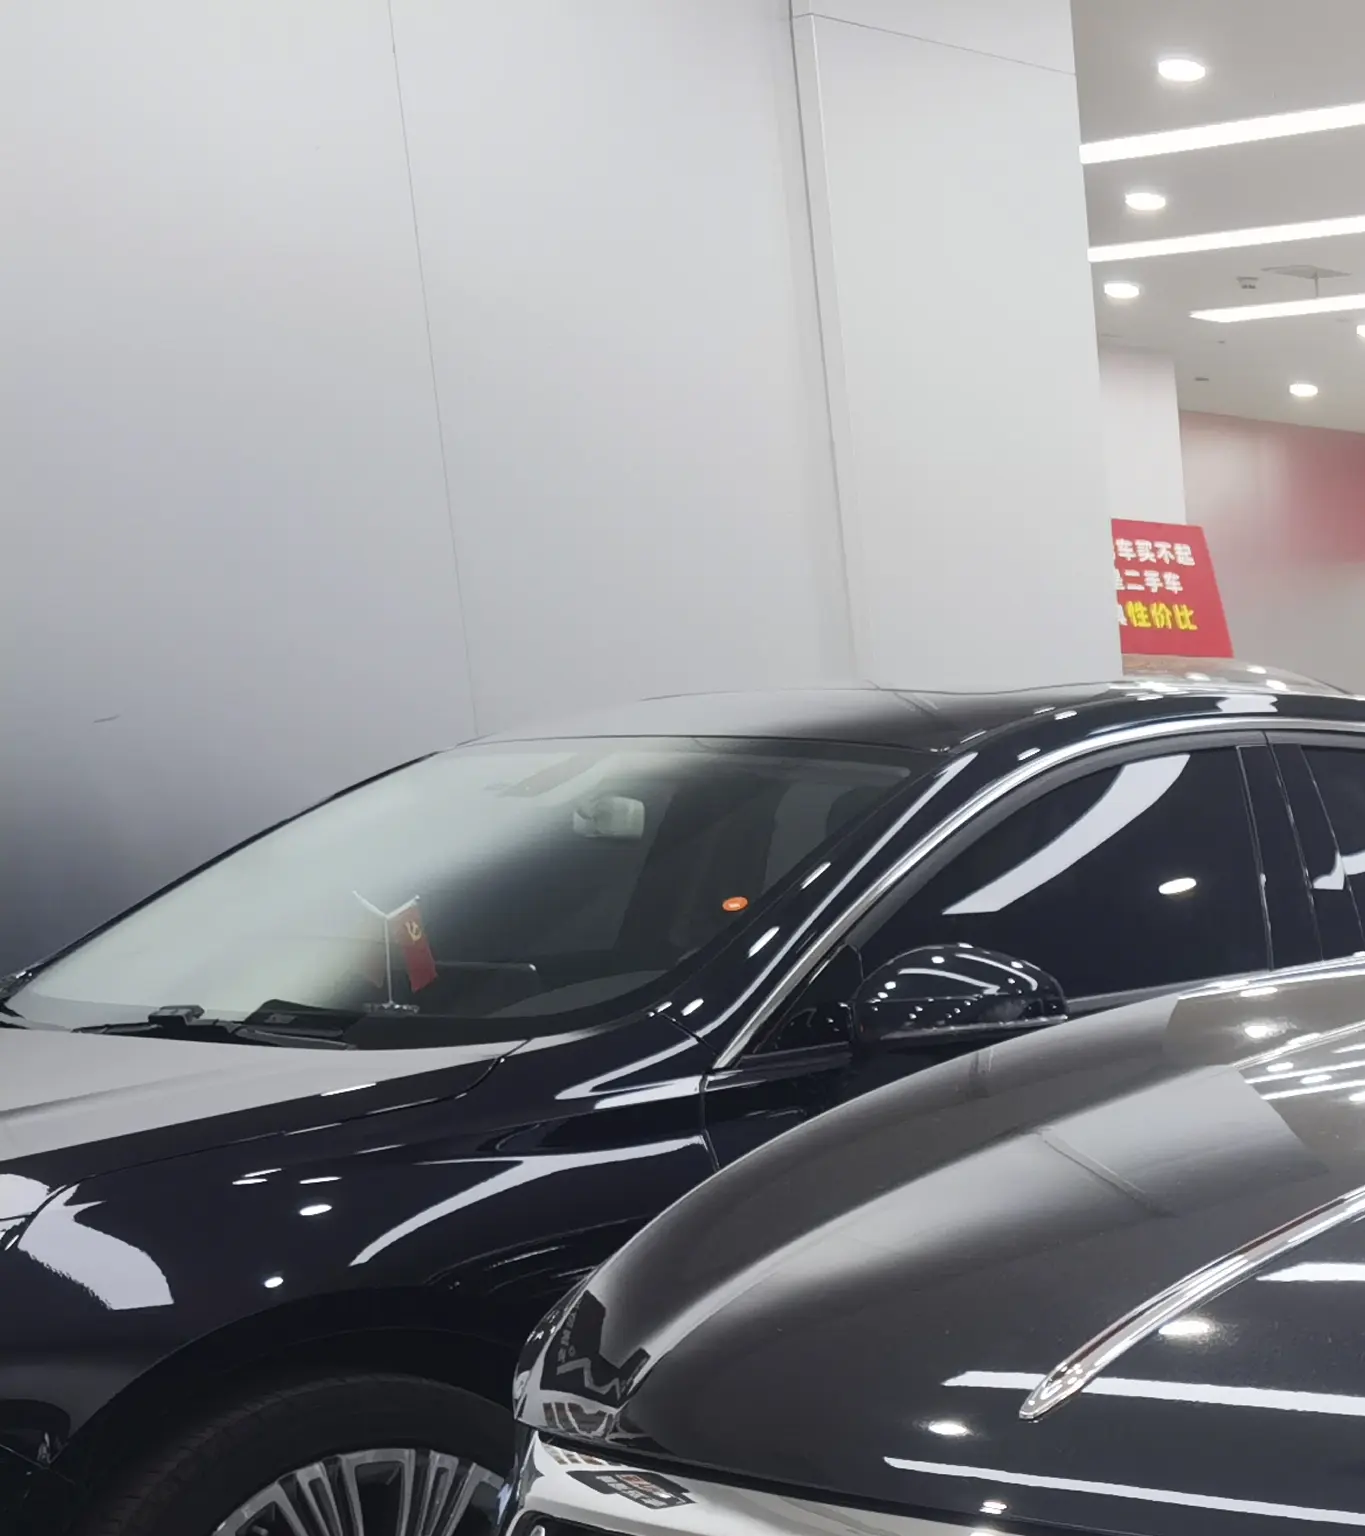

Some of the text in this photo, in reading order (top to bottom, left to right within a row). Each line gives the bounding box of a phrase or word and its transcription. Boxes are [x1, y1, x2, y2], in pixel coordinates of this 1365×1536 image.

[1113, 538, 1195, 566] 车买不起
[1117, 601, 1198, 630] 性价比
